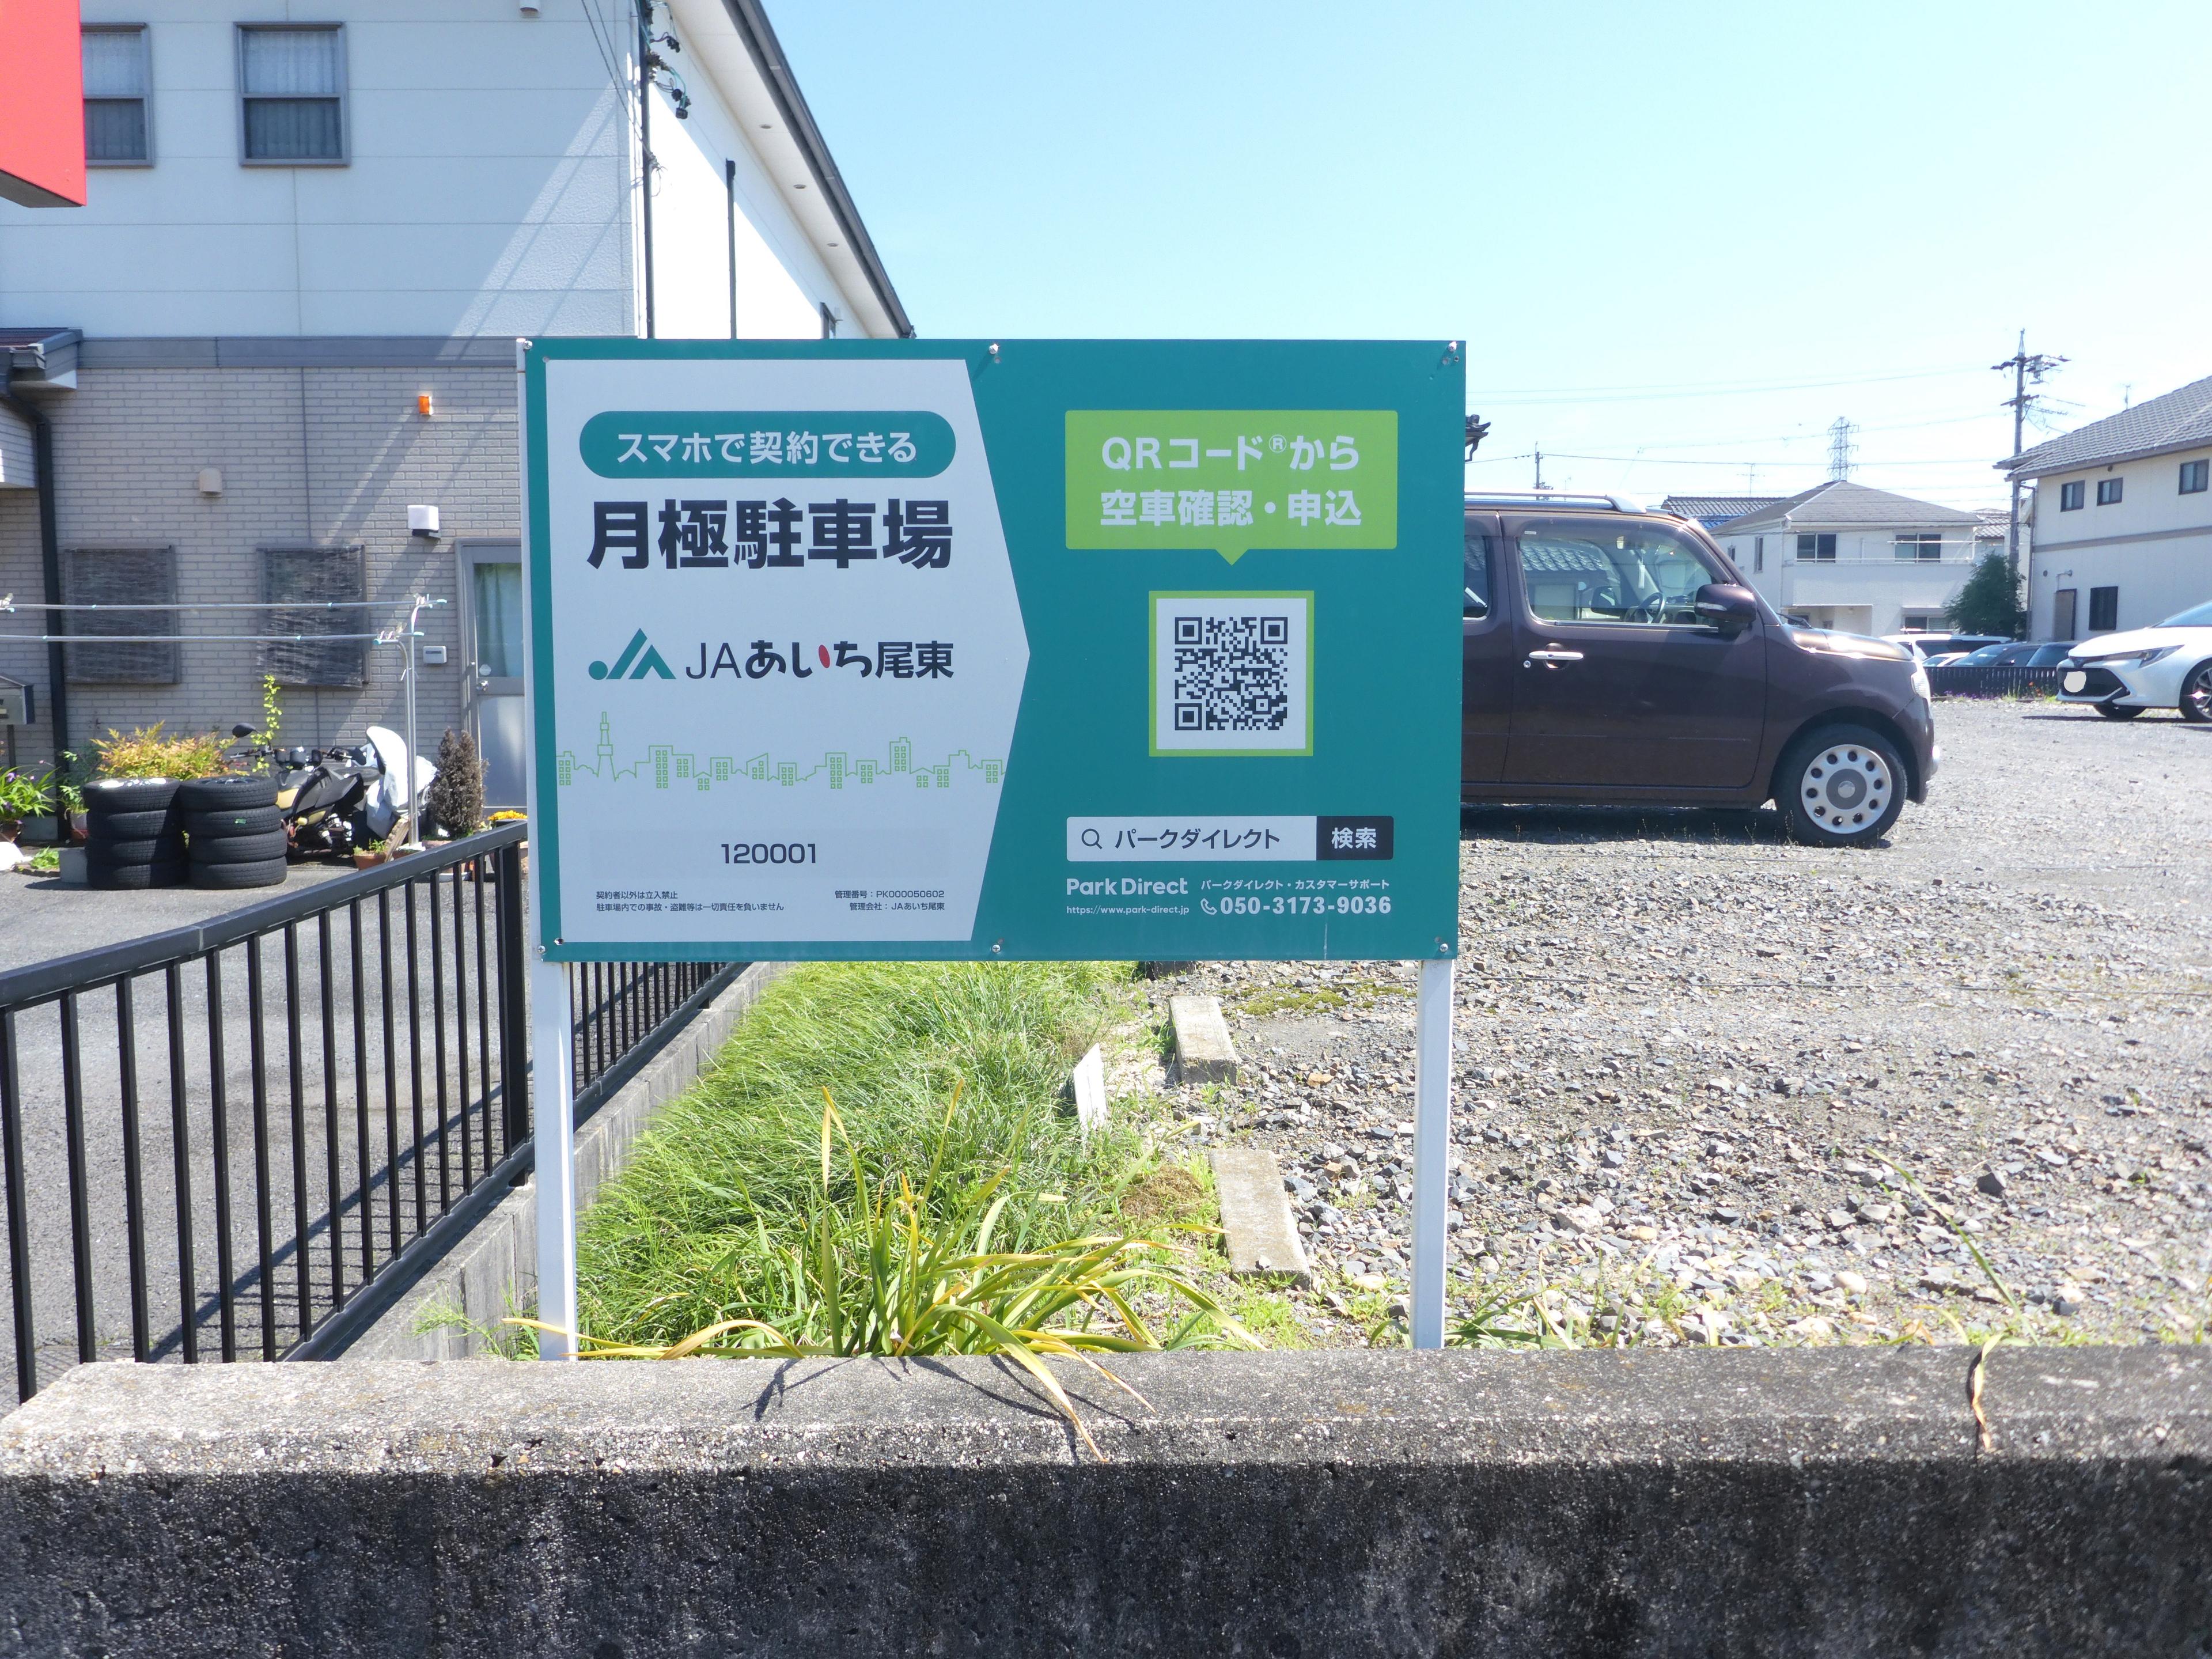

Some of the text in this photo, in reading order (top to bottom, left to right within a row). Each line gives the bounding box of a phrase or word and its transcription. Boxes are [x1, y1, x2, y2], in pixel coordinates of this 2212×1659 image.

[616, 431, 917, 465] スマホで契約できる
[1100, 489, 1362, 527] 空車確認・申込
[586, 497, 953, 570] 月極駐車場
[685, 639, 955, 679] JAあいち尾東
[1115, 828, 1281, 850] パークダイレクト
[1331, 827, 1377, 849] 検索
[721, 843, 816, 864] 120001
[1066, 877, 1188, 895] Park Direct
[1201, 879, 1389, 890] パークダイレクト・カスタマーサポート
[596, 891, 678, 900] 契約者以外は立入禁止
[1220, 896, 1391, 915] 050-3173-9036
[596, 903, 784, 912] 駐車場内での事故・盗難等は一切責任を負いません
[1066, 905, 1190, 915] https://www.park-direct.jp
